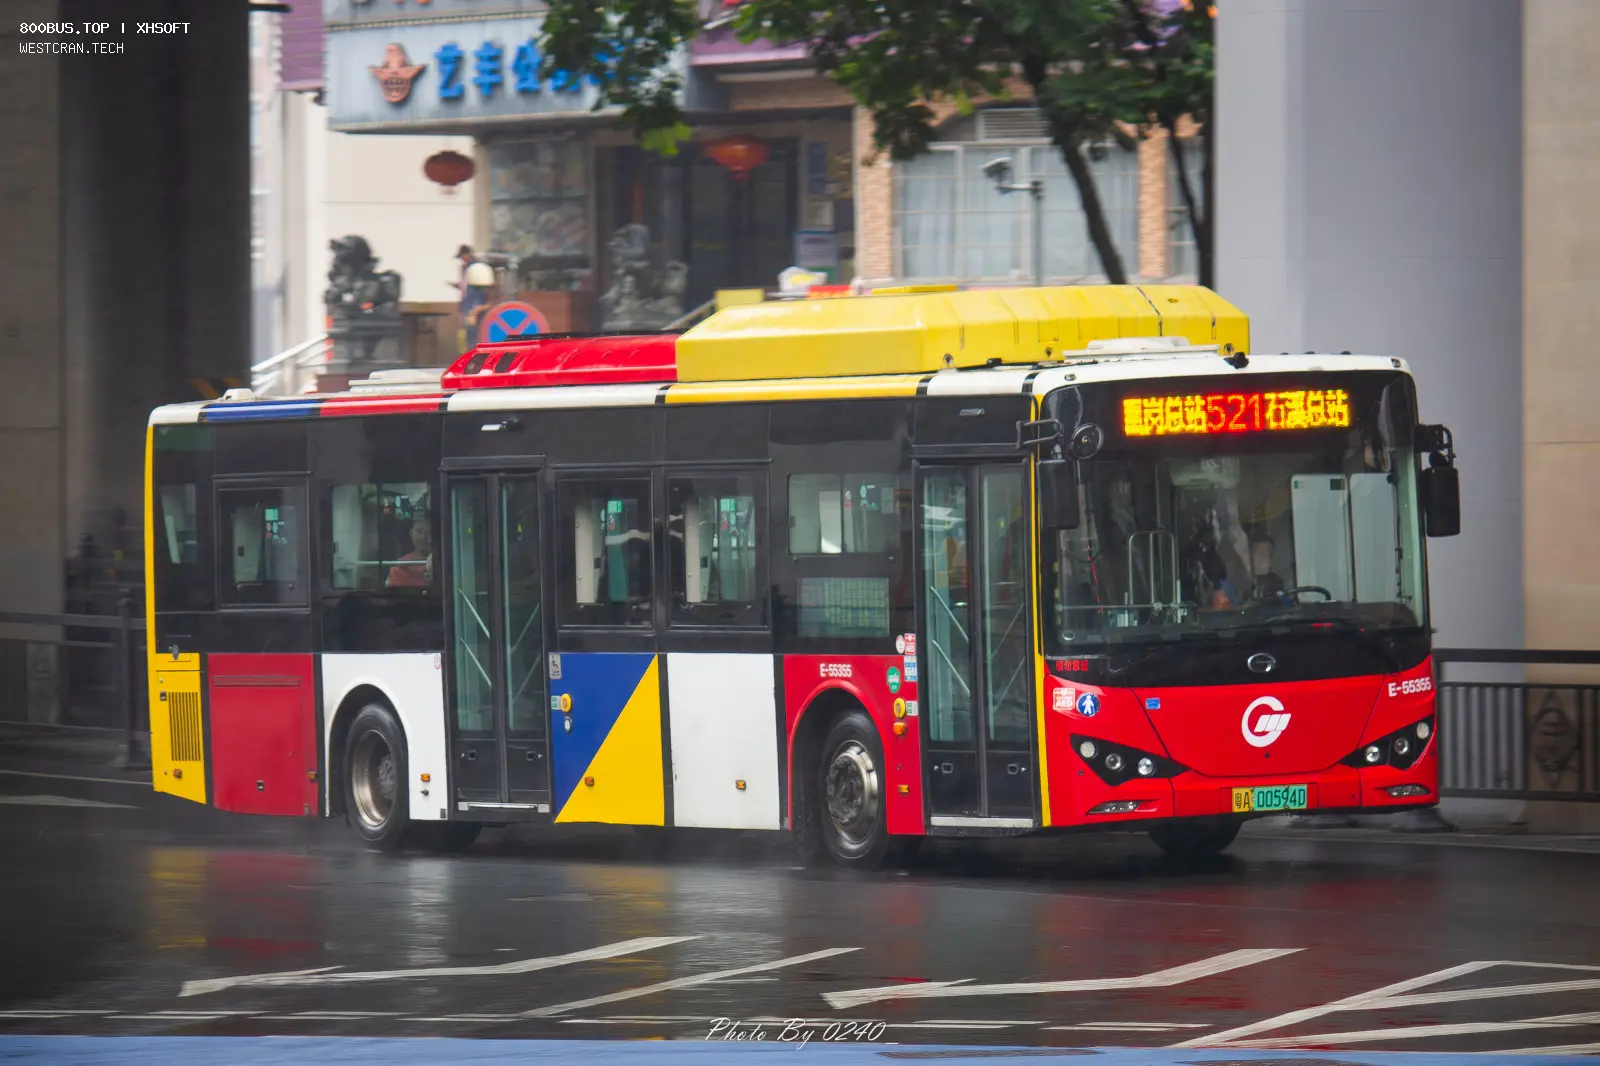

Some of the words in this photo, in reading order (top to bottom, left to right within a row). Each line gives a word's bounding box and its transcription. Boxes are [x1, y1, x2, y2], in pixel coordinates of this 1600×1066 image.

[1207, 394, 1262, 432] 521
[820, 663, 852, 678] E-55355
[1388, 677, 1432, 697] E-55355
[1257, 788, 1306, 808] 00594D
